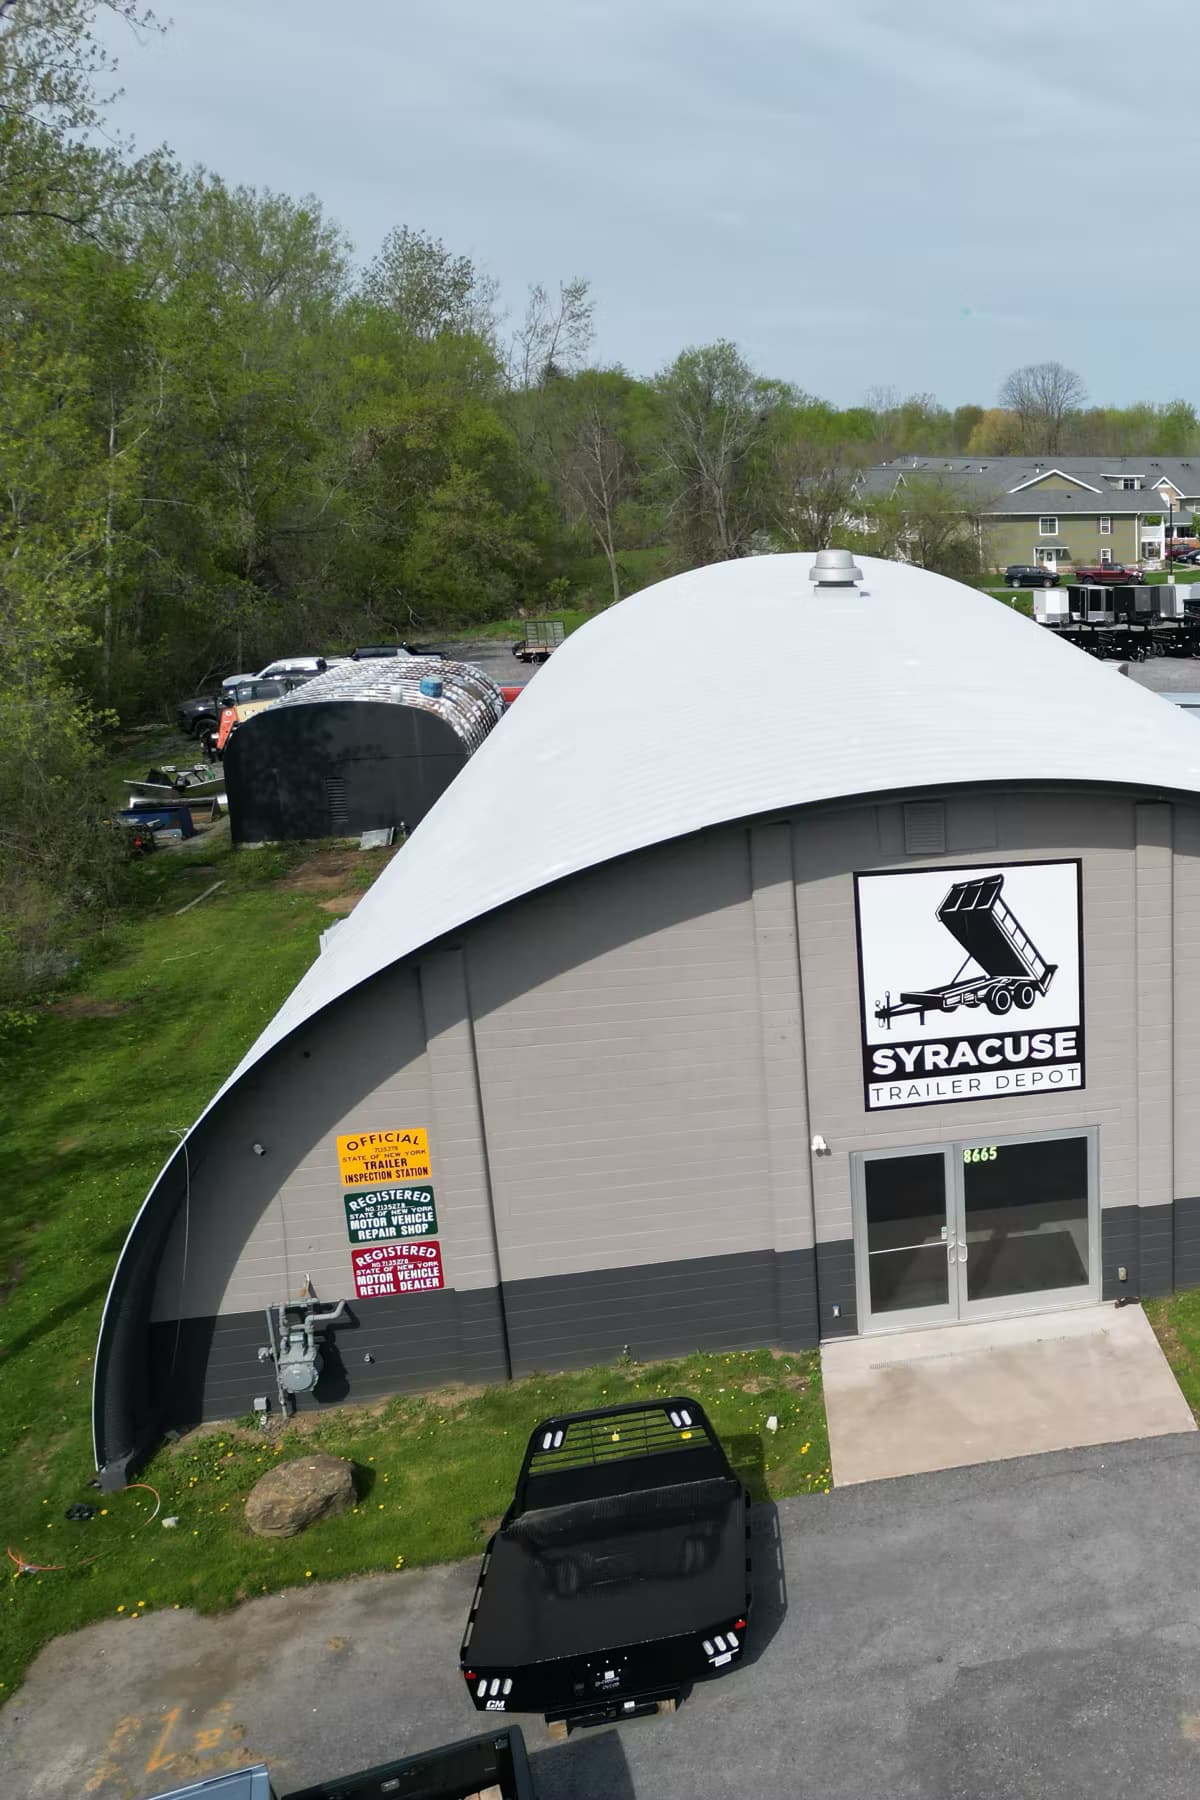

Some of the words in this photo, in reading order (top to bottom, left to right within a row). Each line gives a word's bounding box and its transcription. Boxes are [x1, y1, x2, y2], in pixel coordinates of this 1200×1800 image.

[872, 1031, 1077, 1075] SYRACUSE
[871, 1078, 981, 1101] TRAILER
[996, 1068, 1079, 1089] DEPOT
[346, 1133, 419, 1151] OFFICIAL
[963, 1145, 998, 1163] 8665
[363, 1158, 408, 1171] TRAILER
[345, 1170, 392, 1184] INSPECTION
[396, 1166, 429, 1178] STATION
[349, 1189, 431, 1211] REGISTERED
[350, 1212, 374, 1220] STATE
[391, 1208, 408, 1216] NEW
[411, 1205, 433, 1213] YORK
[350, 1217, 388, 1230] MOTOR
[391, 1212, 434, 1226] VEHICLE
[358, 1227, 397, 1240] REPAIR
[401, 1223, 429, 1236] SHOP
[356, 1245, 437, 1267] REGISTERED
[356, 1268, 381, 1276] STATE
[397, 1263, 414, 1271] NEW
[418, 1260, 439, 1268] YORK
[357, 1273, 393, 1286] MOTOR
[397, 1267, 440, 1280] VEHICLE
[360, 1283, 397, 1296] RETAIL
[400, 1277, 439, 1291] DEALER
